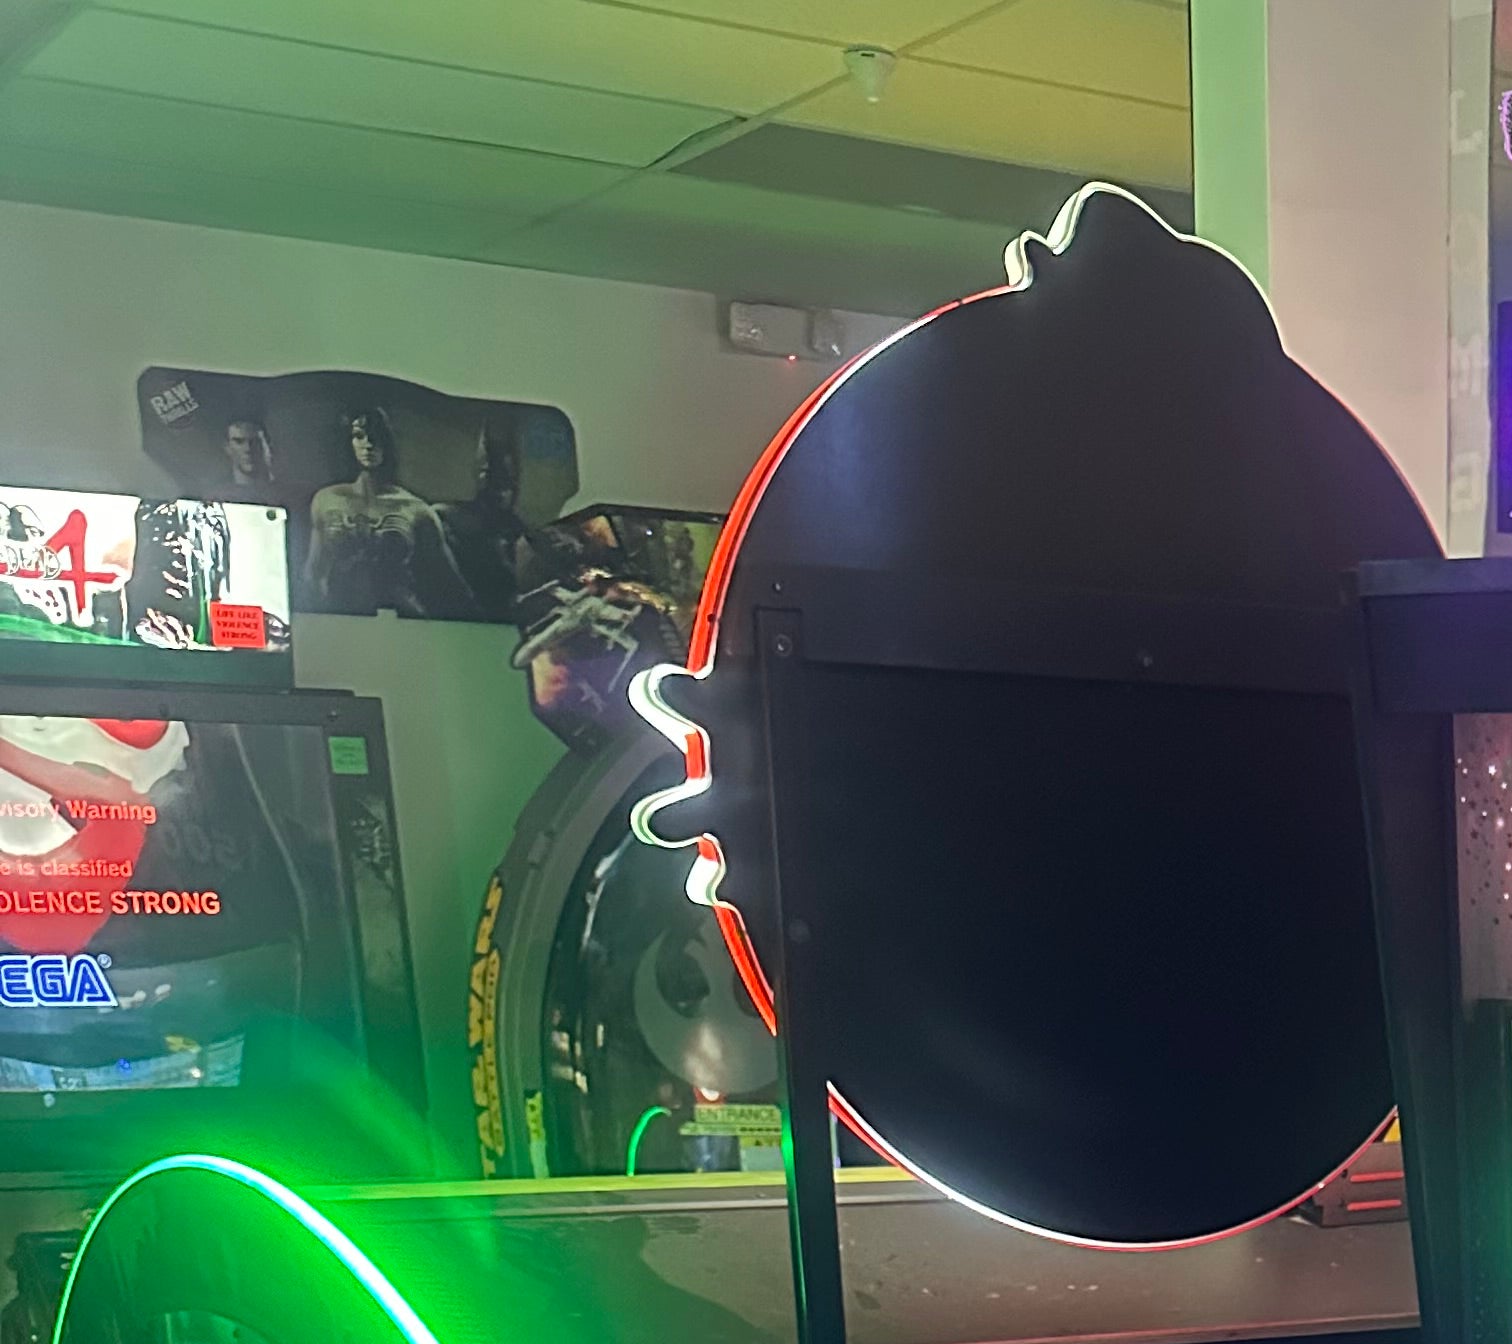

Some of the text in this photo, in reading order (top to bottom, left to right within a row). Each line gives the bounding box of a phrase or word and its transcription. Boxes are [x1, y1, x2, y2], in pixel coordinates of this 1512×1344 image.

[66, 800, 156, 824] Warning
[41, 860, 133, 878] classified
[111, 891, 220, 915] STRONG
